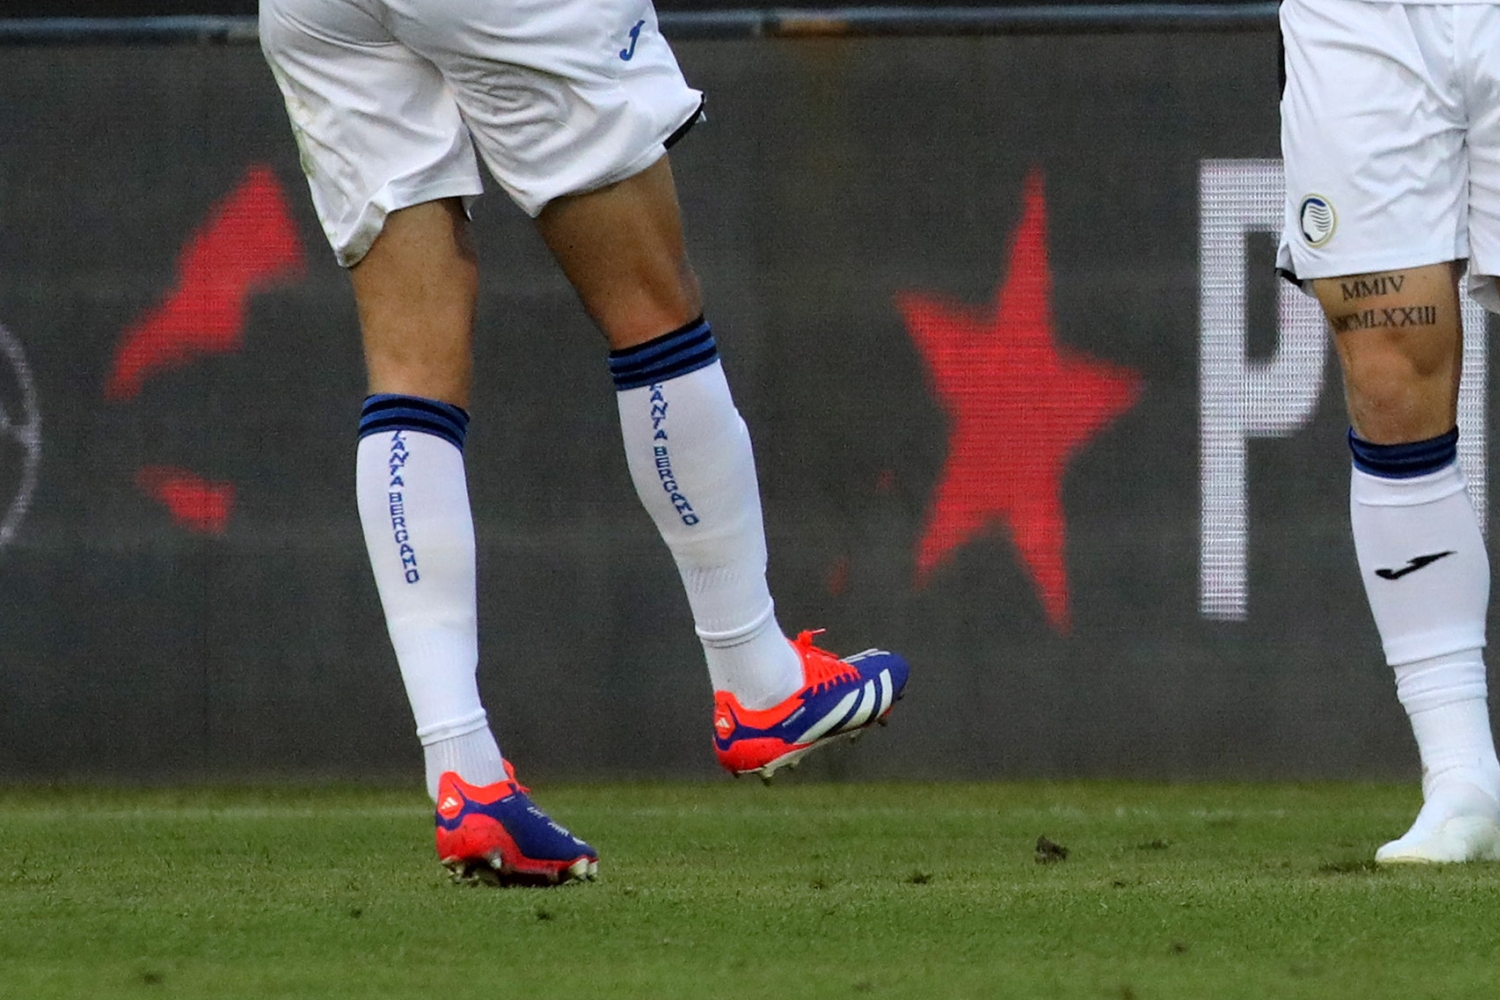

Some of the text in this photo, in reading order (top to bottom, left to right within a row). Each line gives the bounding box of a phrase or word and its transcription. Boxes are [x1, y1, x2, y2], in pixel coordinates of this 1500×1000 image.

[1341, 275, 1404, 301] MMIV
[654, 446, 699, 526] BERGAMO
[389, 492, 420, 584] BERGAMO
